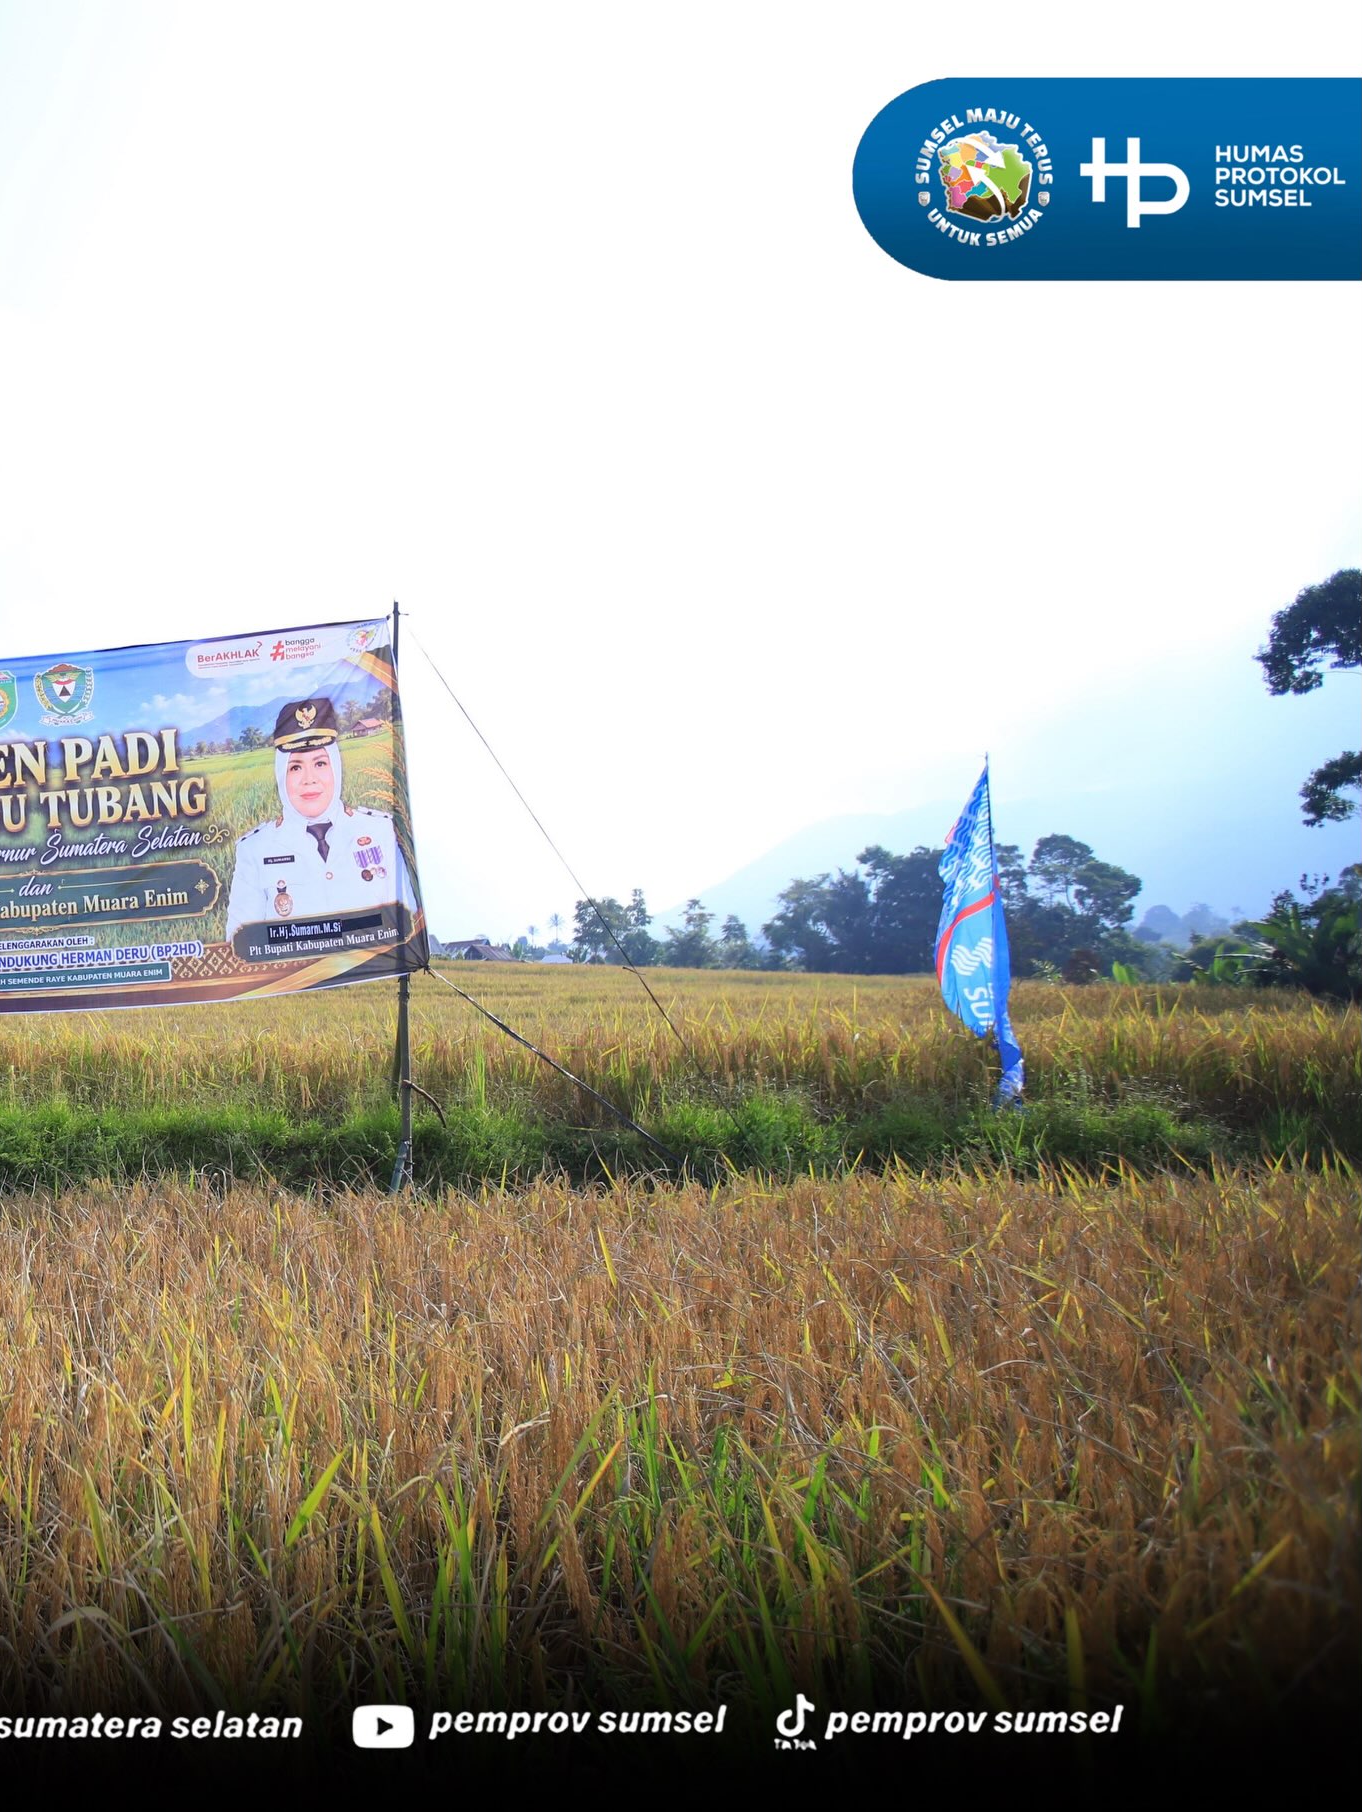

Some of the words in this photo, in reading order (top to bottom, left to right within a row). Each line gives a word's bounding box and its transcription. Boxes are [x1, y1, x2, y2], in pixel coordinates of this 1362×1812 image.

[285, 638, 315, 646] bangga
[286, 643, 321, 652] melayani
[197, 648, 260, 663] BerAKHLAK
[61, 728, 180, 782] PADI
[40, 776, 207, 829] TUBANG
[40, 832, 127, 866] Sumatera
[131, 824, 203, 858] Selatan
[18, 876, 54, 897] dan
[83, 894, 140, 914] Muara
[144, 888, 189, 908] Enim
[66, 937, 88, 946] OLEH
[249, 944, 262, 956] Plt
[264, 942, 294, 956] Bupati
[296, 937, 344, 951] Kabupaten
[346, 933, 375, 946] Muara
[378, 927, 400, 940] Enim
[61, 951, 112, 965] HERMAN
[116, 947, 148, 960] DERU
[152, 942, 202, 960] (BP2HD)
[8, 976, 44, 985] SEMENDE
[46, 974, 66, 982] RAYE
[67, 972, 112, 982] KABUPATEN
[114, 970, 141, 979] MUARA
[144, 968, 163, 977] ENIM
